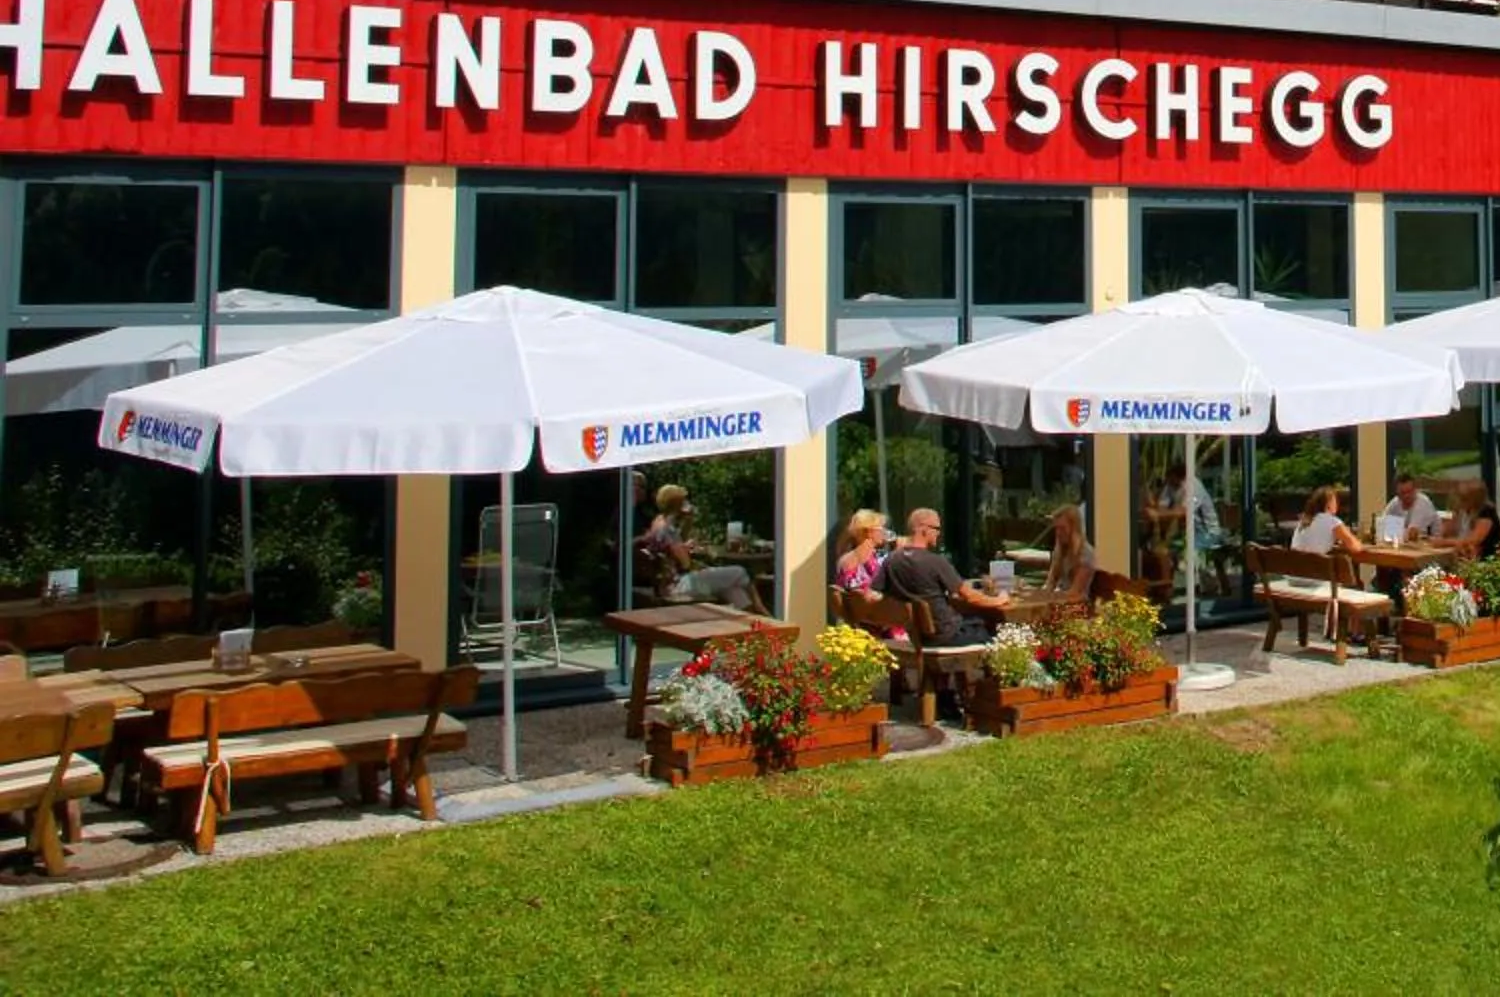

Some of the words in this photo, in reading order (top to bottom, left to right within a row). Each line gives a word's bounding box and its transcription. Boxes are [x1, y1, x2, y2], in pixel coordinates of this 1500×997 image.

[825, 41, 1393, 149] HIRSCHEGG
[620, 411, 762, 447] MEMMINGER
[1101, 400, 1232, 422] MEMMINGER
